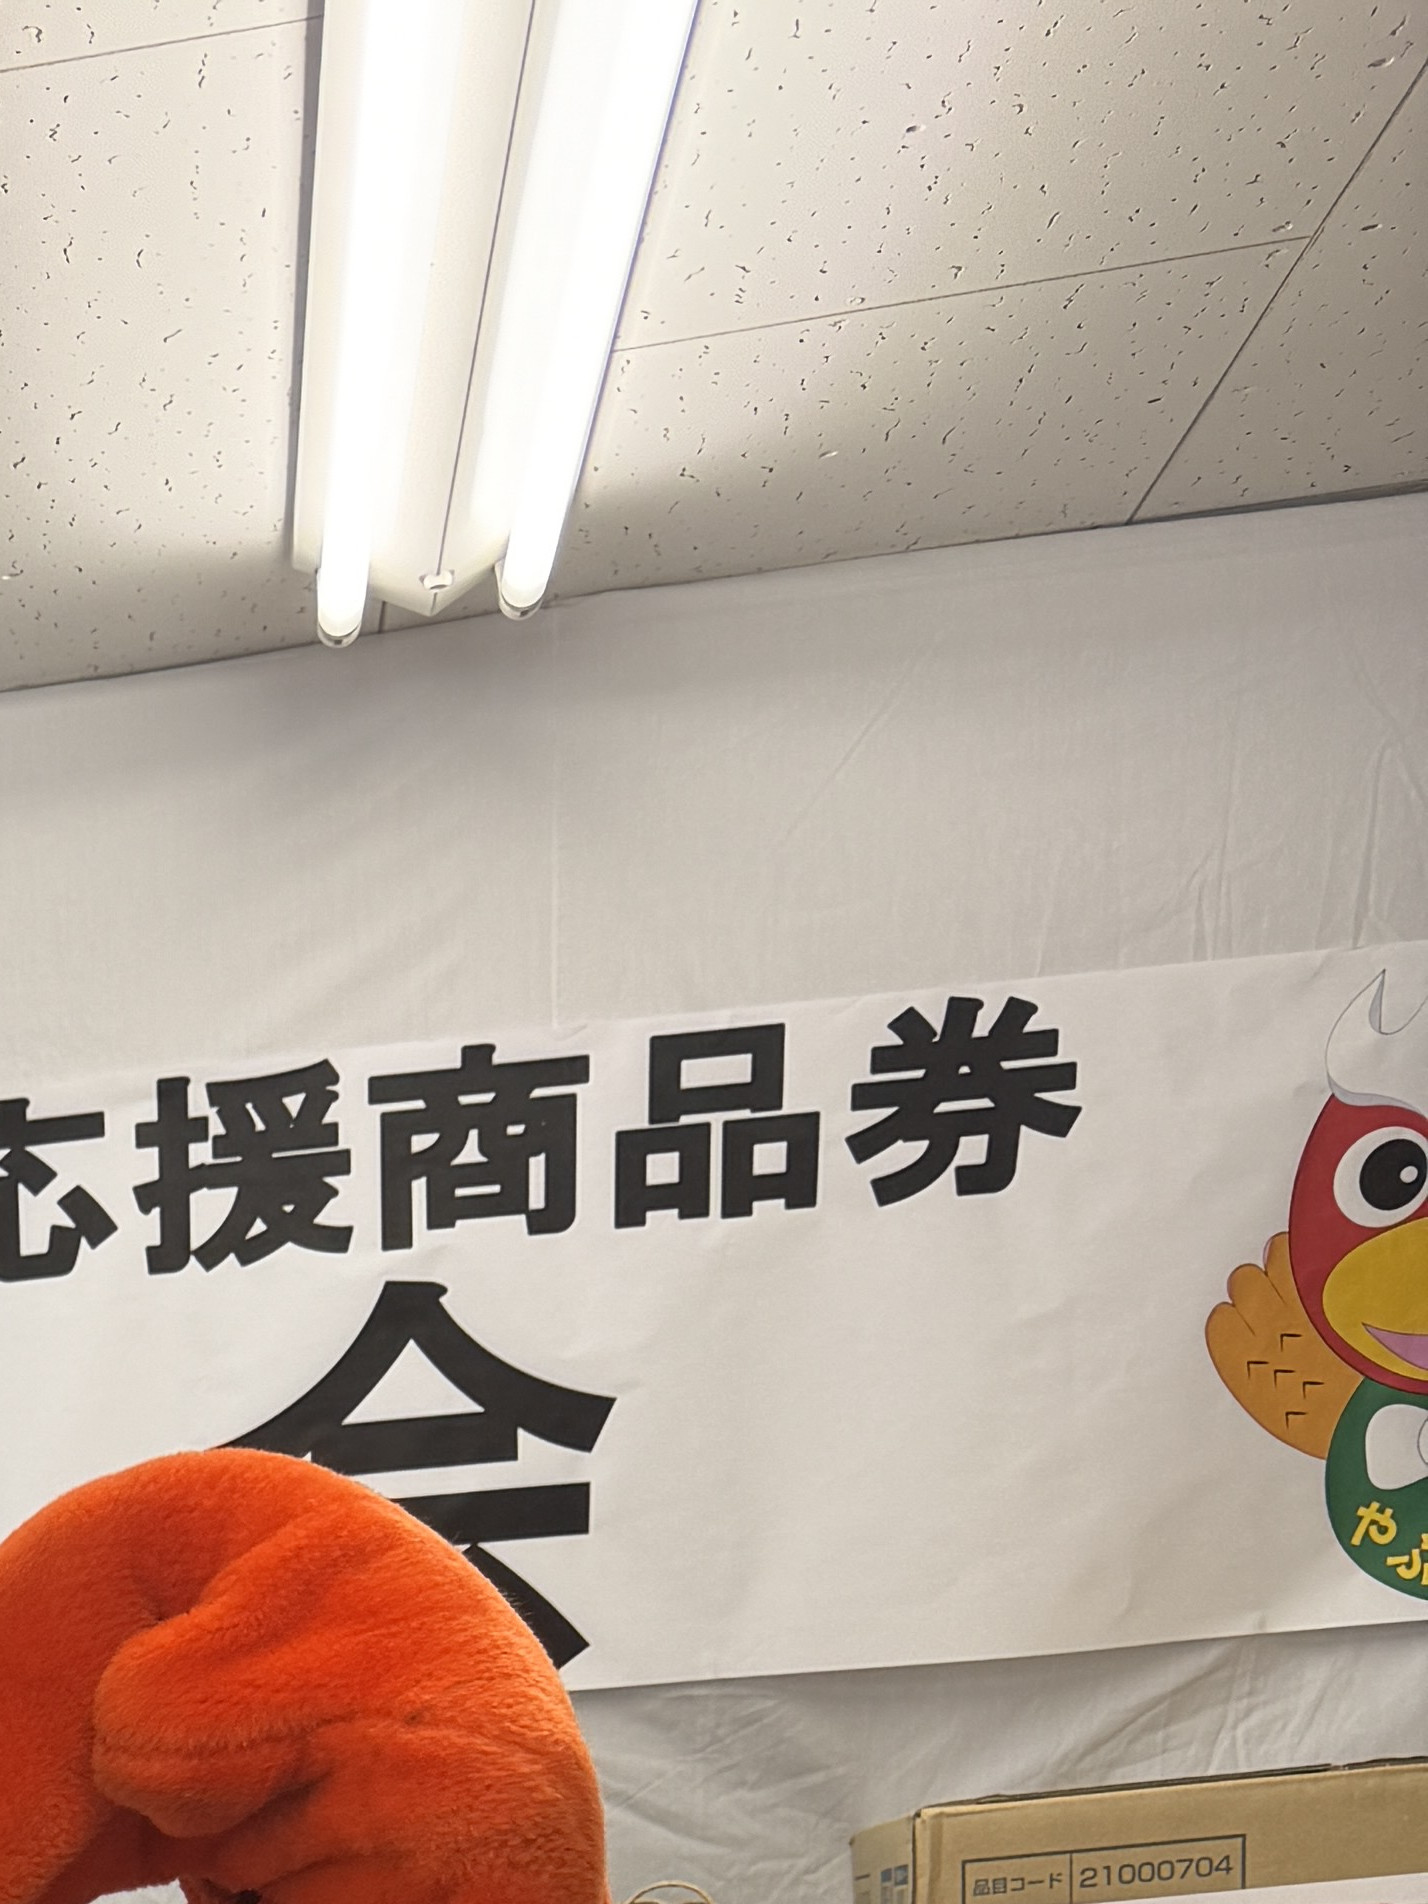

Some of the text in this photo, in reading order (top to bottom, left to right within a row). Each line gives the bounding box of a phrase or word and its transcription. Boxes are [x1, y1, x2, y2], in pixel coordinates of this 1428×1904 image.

[973, 1855, 1234, 1897] 品目コード 21000704
